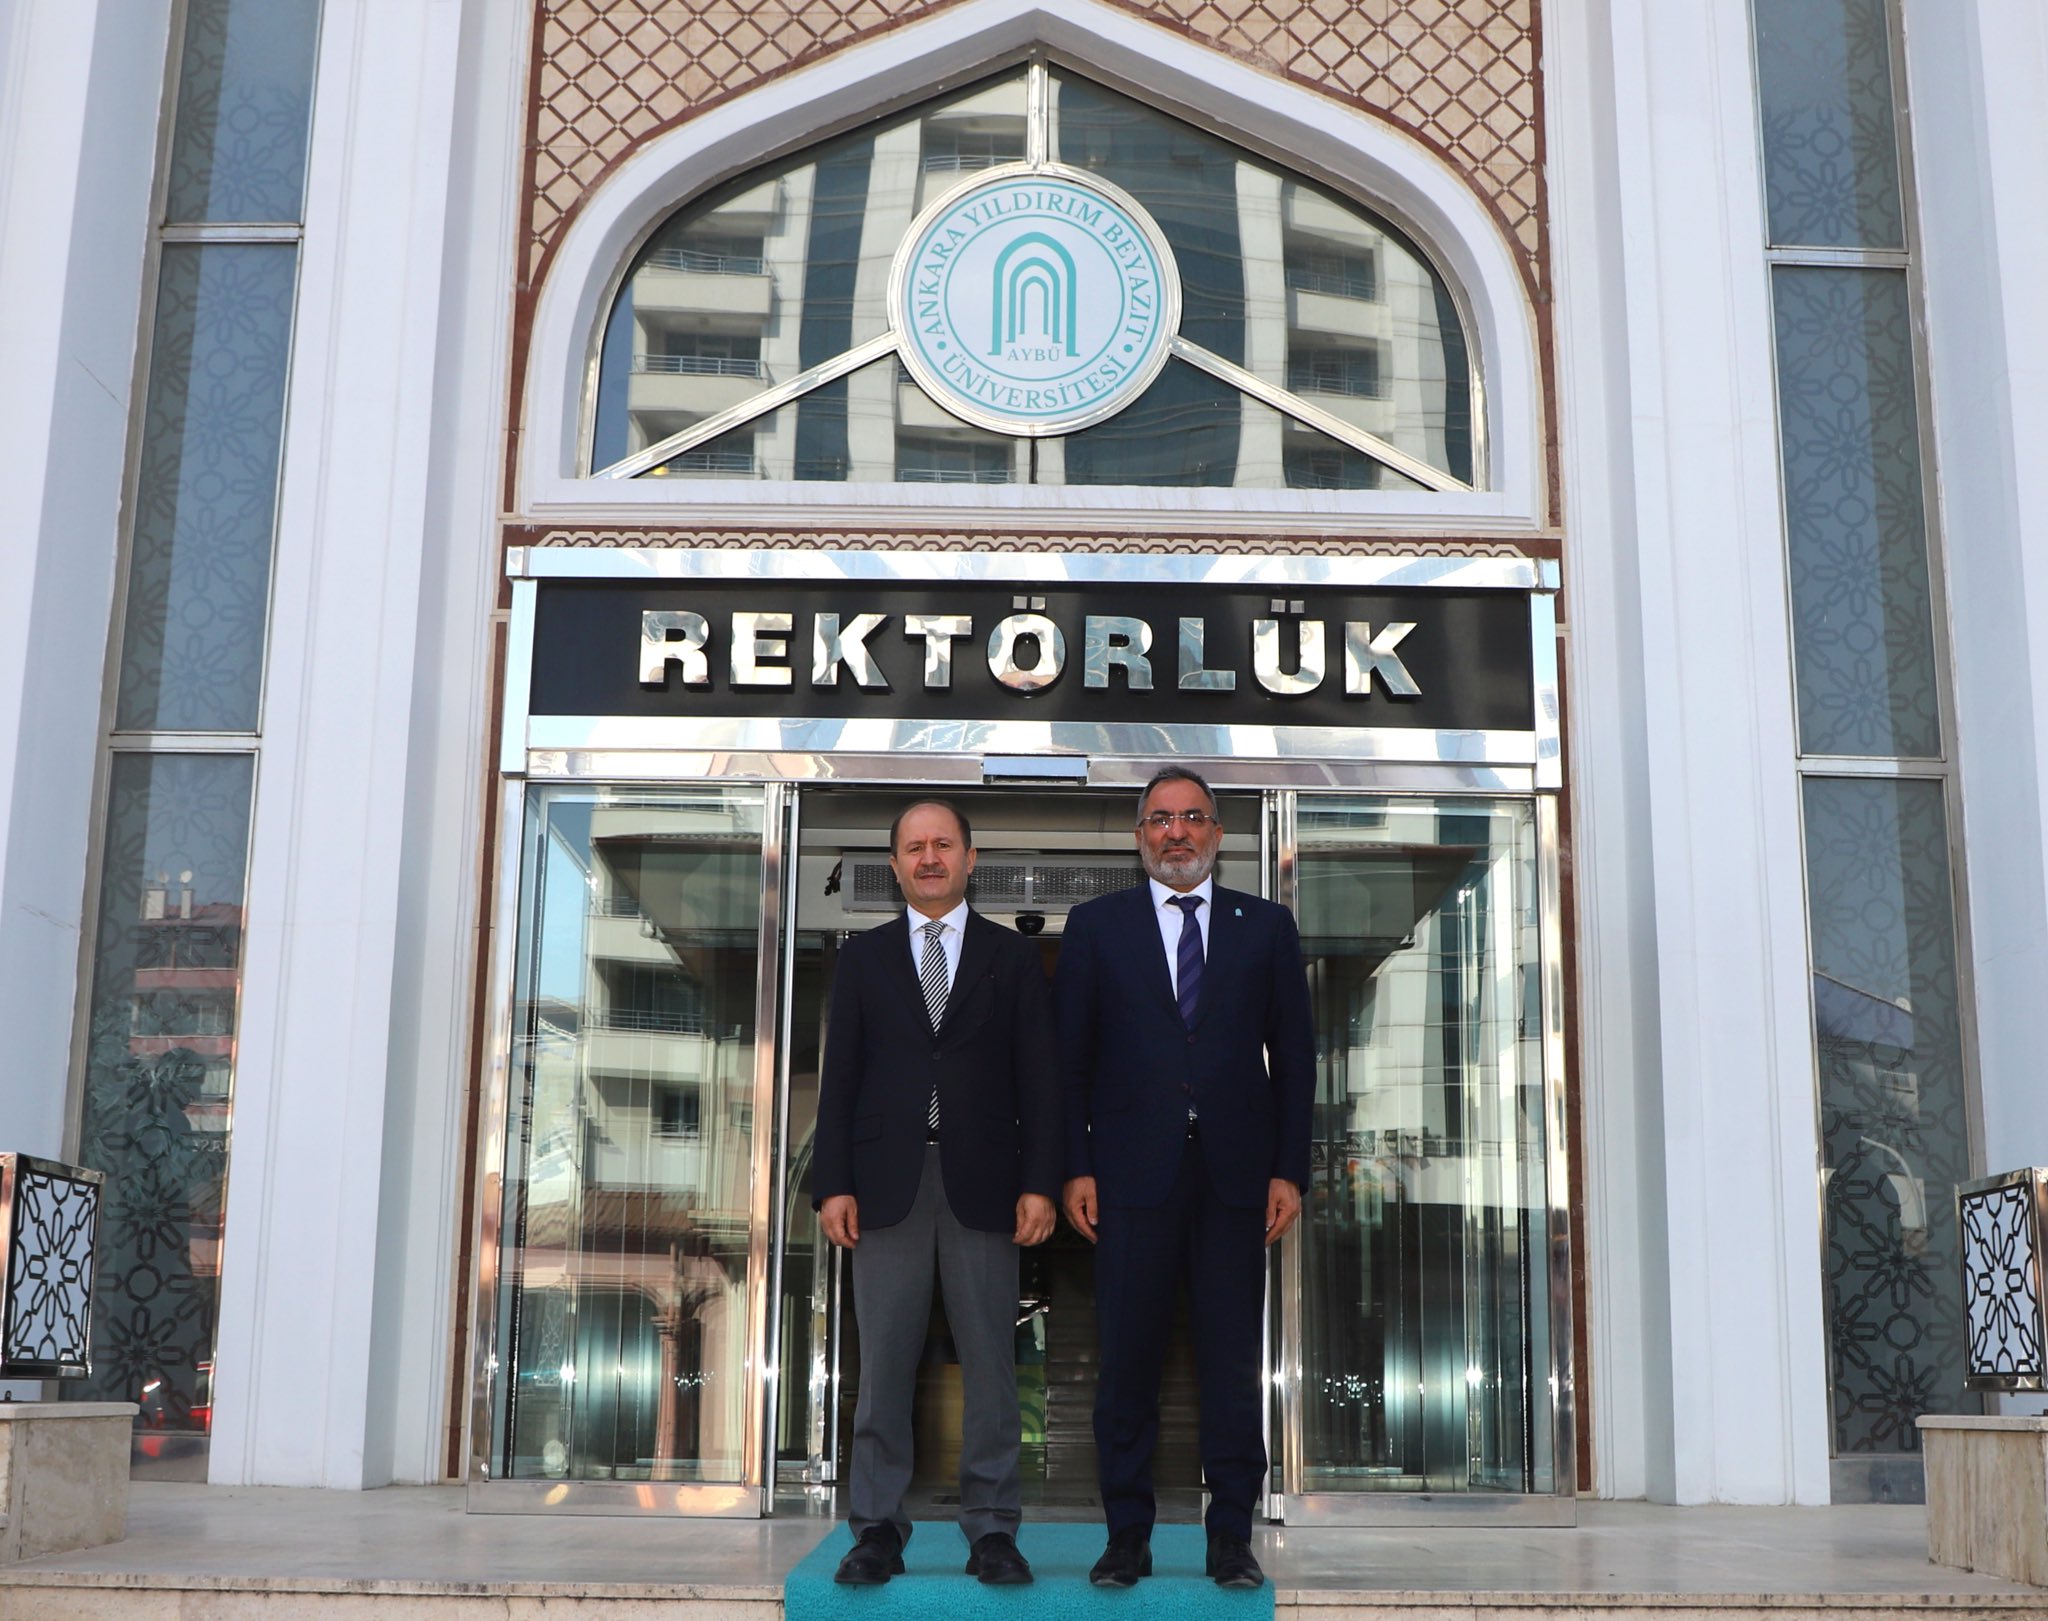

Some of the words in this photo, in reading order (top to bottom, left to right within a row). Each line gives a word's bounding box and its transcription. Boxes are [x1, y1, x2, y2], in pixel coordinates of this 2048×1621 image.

[919, 228, 966, 337] ANKARA
[963, 191, 1105, 229] YILDIRIM
[1102, 221, 1151, 343] BEYAZIT
[942, 353, 1128, 409] ÜNİVERSİTESİ
[1007, 345, 1061, 362] AYBÜ
[638, 594, 1423, 697] REKTÖRLÜK
